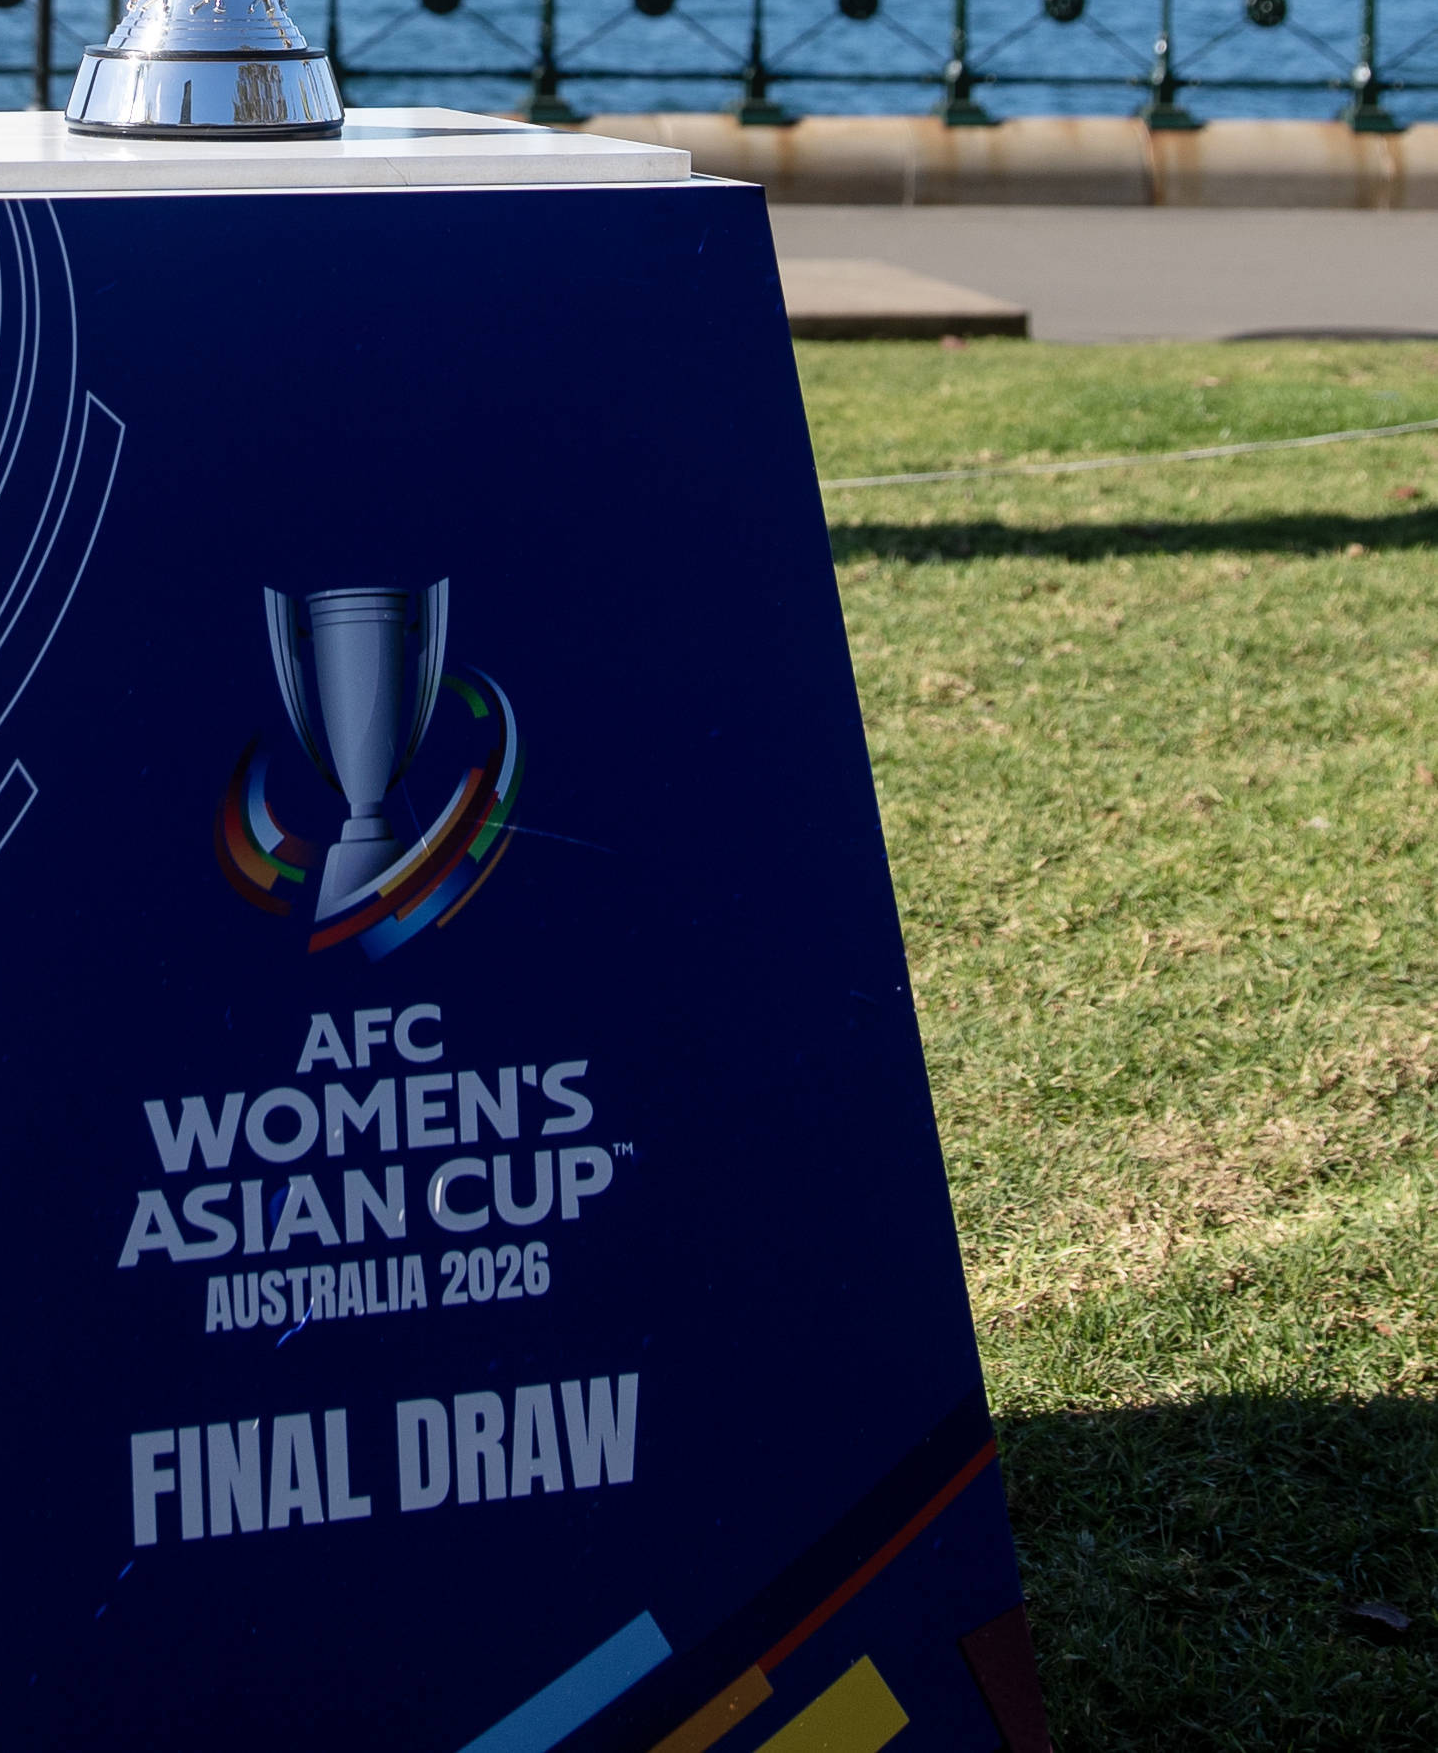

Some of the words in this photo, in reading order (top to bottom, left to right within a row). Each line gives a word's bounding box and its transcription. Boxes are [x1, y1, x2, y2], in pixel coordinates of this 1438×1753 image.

[296, 1003, 444, 1074] AFC
[143, 1059, 594, 1173] WOMEN'S
[117, 1165, 407, 1268] ASIAN
[205, 1254, 428, 1333] AUSTRALIA
[440, 1241, 551, 1306] 2026
[130, 1408, 372, 1547] FINAL
[396, 1372, 639, 1512] DRAW
